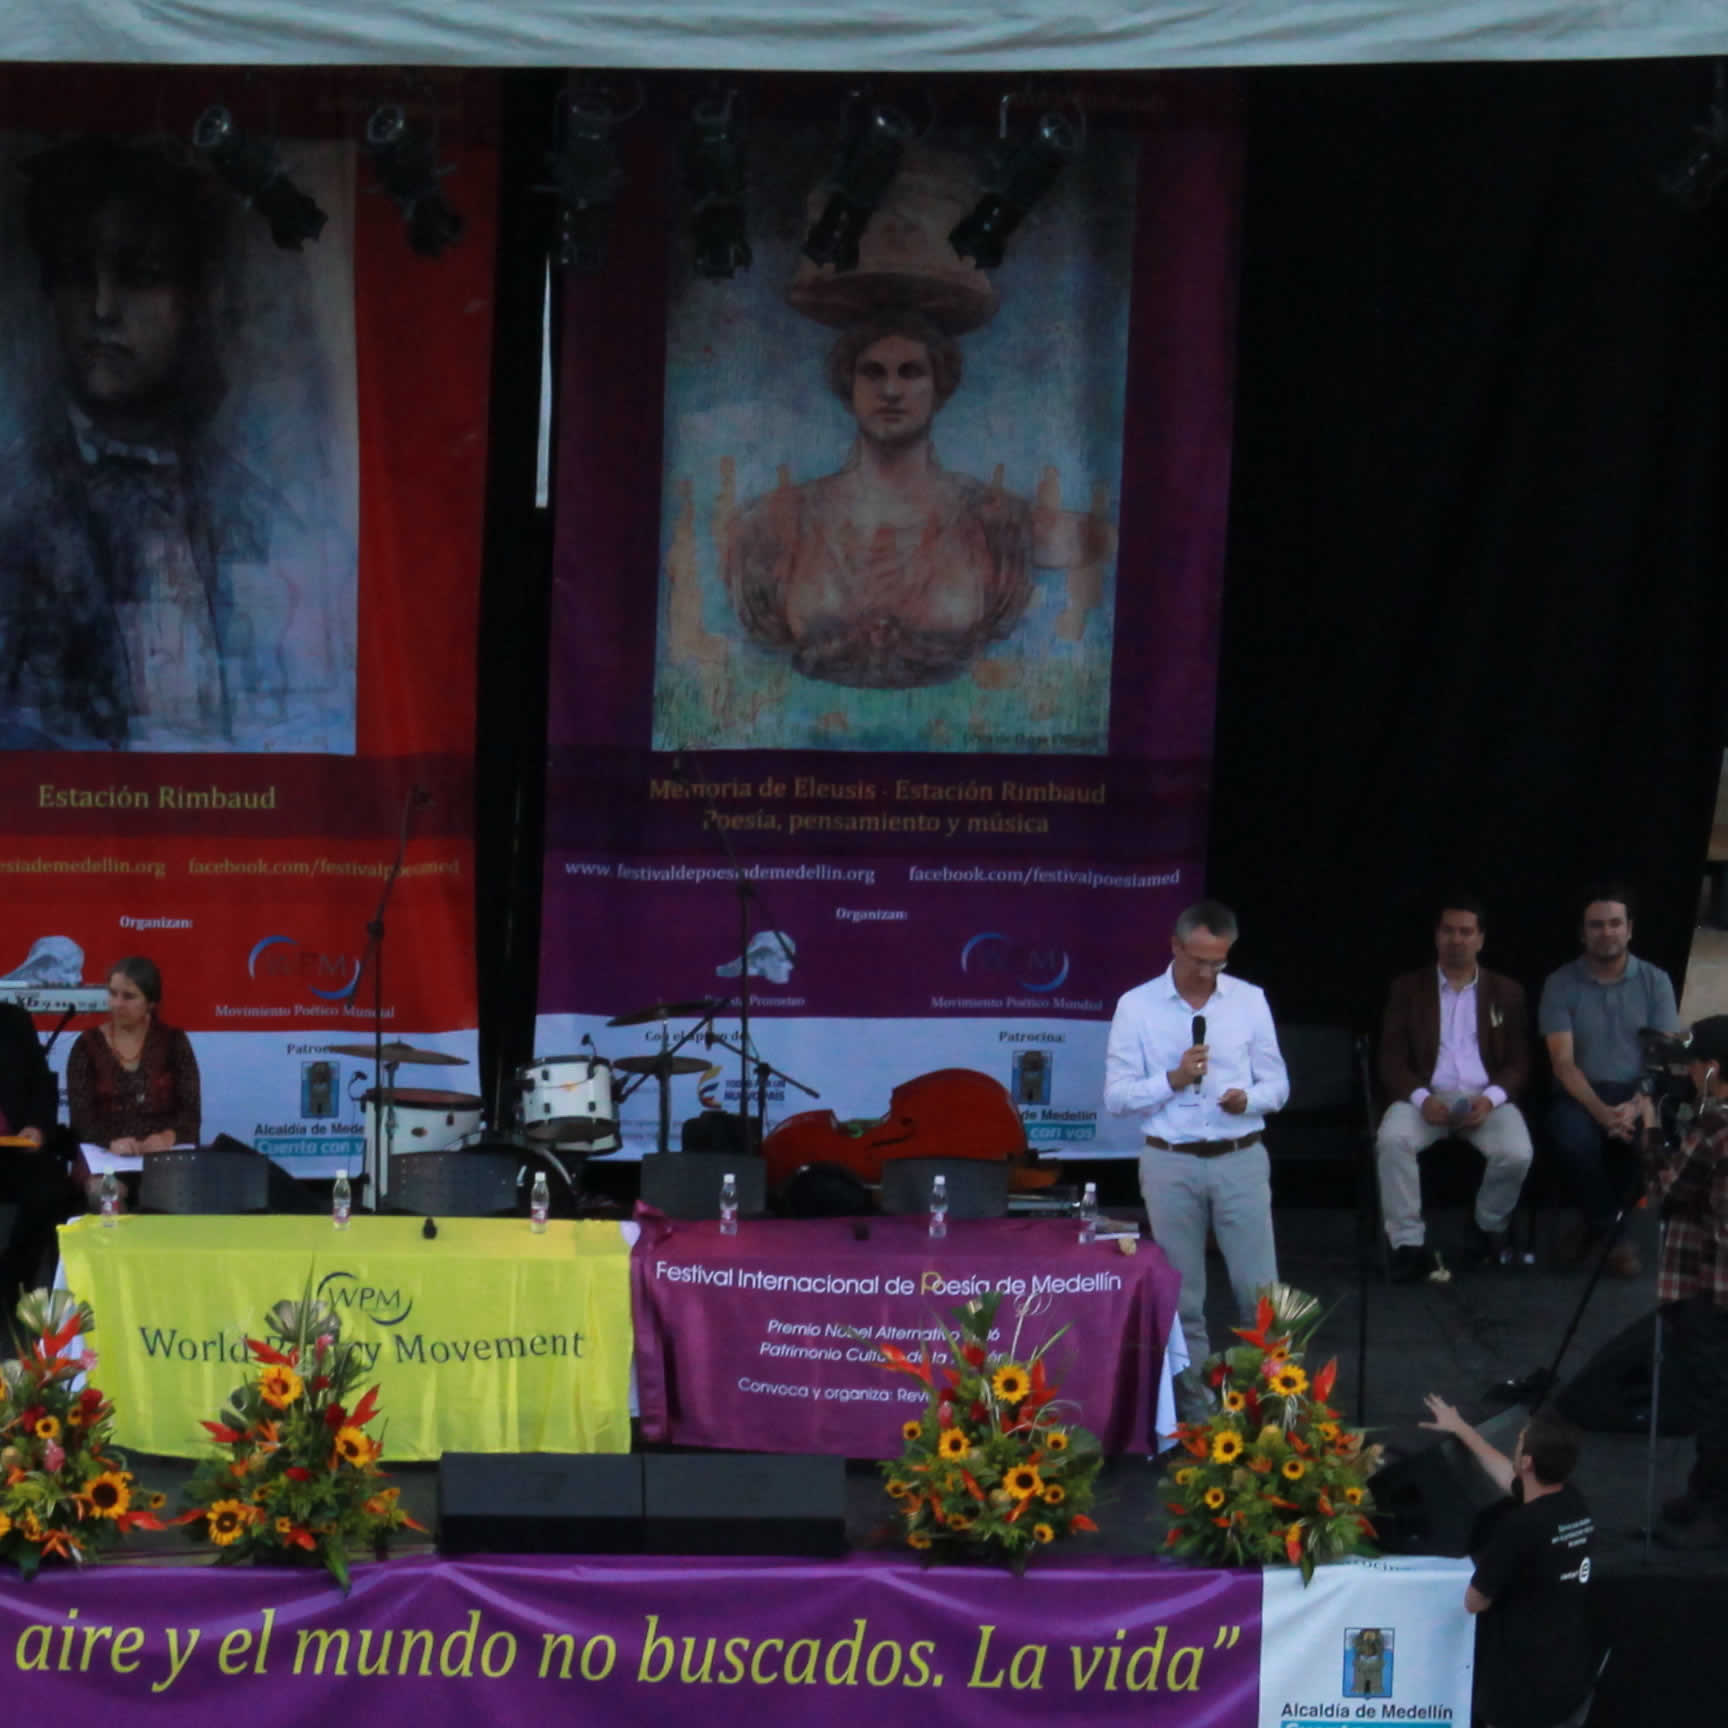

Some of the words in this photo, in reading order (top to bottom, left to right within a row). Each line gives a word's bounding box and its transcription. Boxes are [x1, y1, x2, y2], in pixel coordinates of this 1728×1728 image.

[38, 784, 149, 809] Estación
[158, 786, 277, 810] Rimbaud
[649, 779, 752, 798] Memoria
[759, 779, 786, 798] de
[794, 778, 877, 800] Eleusis
[896, 779, 993, 801] Estación
[1001, 781, 1106, 804] Rimbaud
[789, 810, 940, 835] pensamiento
[946, 816, 959, 838] y
[967, 812, 1049, 833] música
[908, 866, 1180, 888] facebook.com/festivalpoesiamed
[119, 916, 193, 930] Organizan:
[835, 907, 908, 922] Organizan:
[215, 1005, 291, 1017] Movimiento
[294, 1003, 339, 1018] Poético
[1053, 998, 1103, 1011] Mundial
[999, 1031, 1065, 1043] Patrocina:
[1041, 1109, 1097, 1121] Medellín
[255, 1123, 307, 1136] Alcaldía
[311, 1124, 327, 1136] de
[331, 1124, 365, 1135] Mede
[1030, 1126, 1061, 1140] con
[1067, 1128, 1092, 1140] vos
[257, 1140, 317, 1154] Cuenta
[322, 1142, 350, 1154] con
[655, 1262, 733, 1287] Festival
[738, 1269, 879, 1295] Internacional
[884, 1273, 915, 1296] de
[920, 1271, 990, 1296] Poesía
[996, 1272, 1027, 1296] de
[1032, 1271, 1122, 1294] Medellín
[326, 1286, 403, 1310] WPM
[768, 1319, 823, 1337] Premio
[139, 1327, 249, 1363] World
[394, 1330, 587, 1365] Movement
[760, 1341, 842, 1362] Patrimonio
[738, 1378, 810, 1398] Convoca
[811, 1385, 822, 1403] y
[824, 1383, 892, 1404] organiza:
[15, 1609, 142, 1674] aire
[152, 1626, 201, 1692] y
[217, 1608, 277, 1675] el
[293, 1610, 517, 1677] mundo
[537, 1629, 616, 1681] no
[637, 1615, 945, 1688] buscados.
[968, 1625, 1047, 1690] La
[1069, 1626, 1240, 1692] vida”
[1281, 1703, 1350, 1718] Alcaldía
[1355, 1704, 1376, 1718] de
[1382, 1704, 1453, 1719] Medellín
